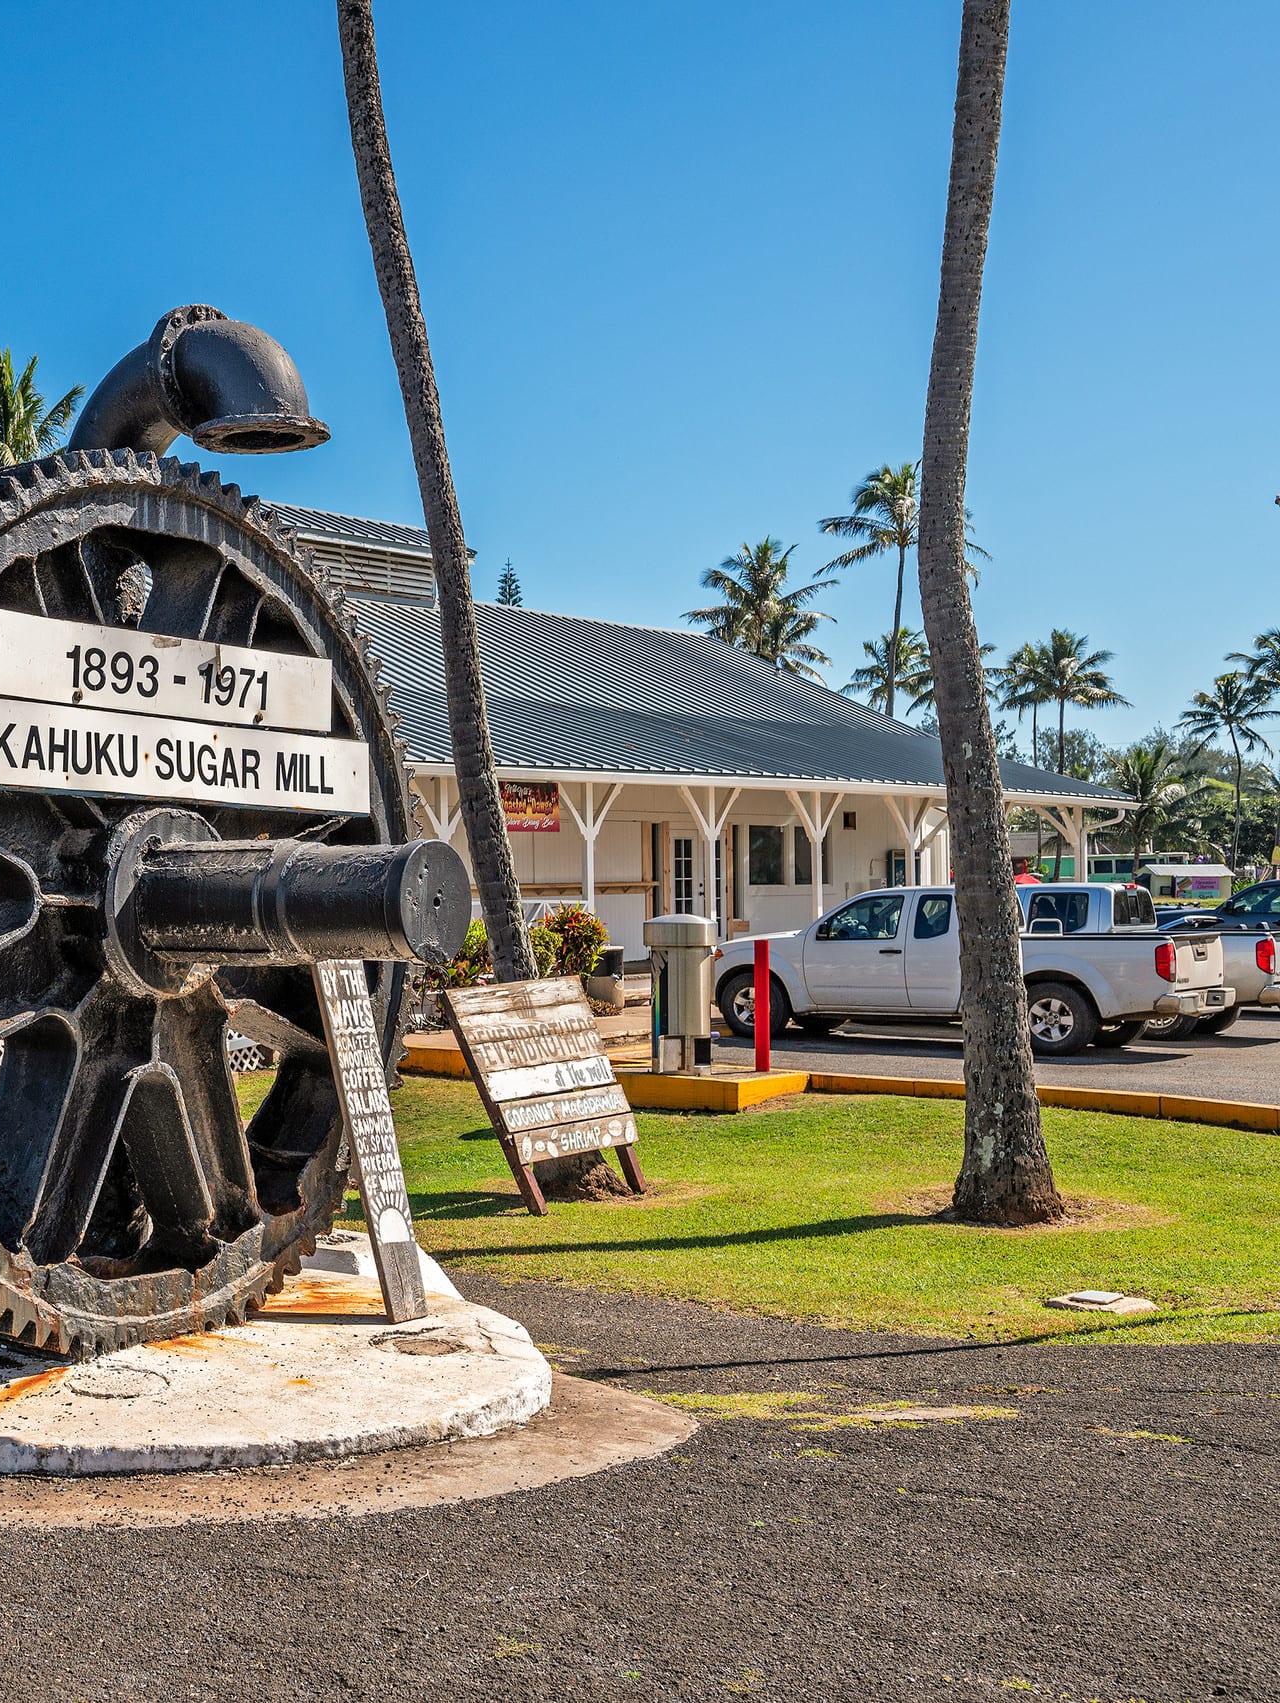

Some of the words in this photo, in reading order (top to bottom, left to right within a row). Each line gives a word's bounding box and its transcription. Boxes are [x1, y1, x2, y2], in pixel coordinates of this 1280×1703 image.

[65, 644, 160, 698] 1893
[198, 662, 269, 711] 1971
[154, 737, 261, 790] SUGAR
[275, 751, 335, 795] MILL
[320, 969, 338, 998] BY
[339, 969, 368, 996] THE
[326, 999, 375, 1029] WAVES
[341, 1067, 385, 1091] COFFEE
[554, 1063, 566, 1087] at
[567, 1064, 587, 1086] the
[586, 1058, 610, 1082] mill
[345, 1087, 391, 1115] SALADS
[504, 1101, 556, 1128] COCONUT
[561, 1093, 623, 1119] MACADAMIA
[560, 1126, 601, 1151] SHRIMP
